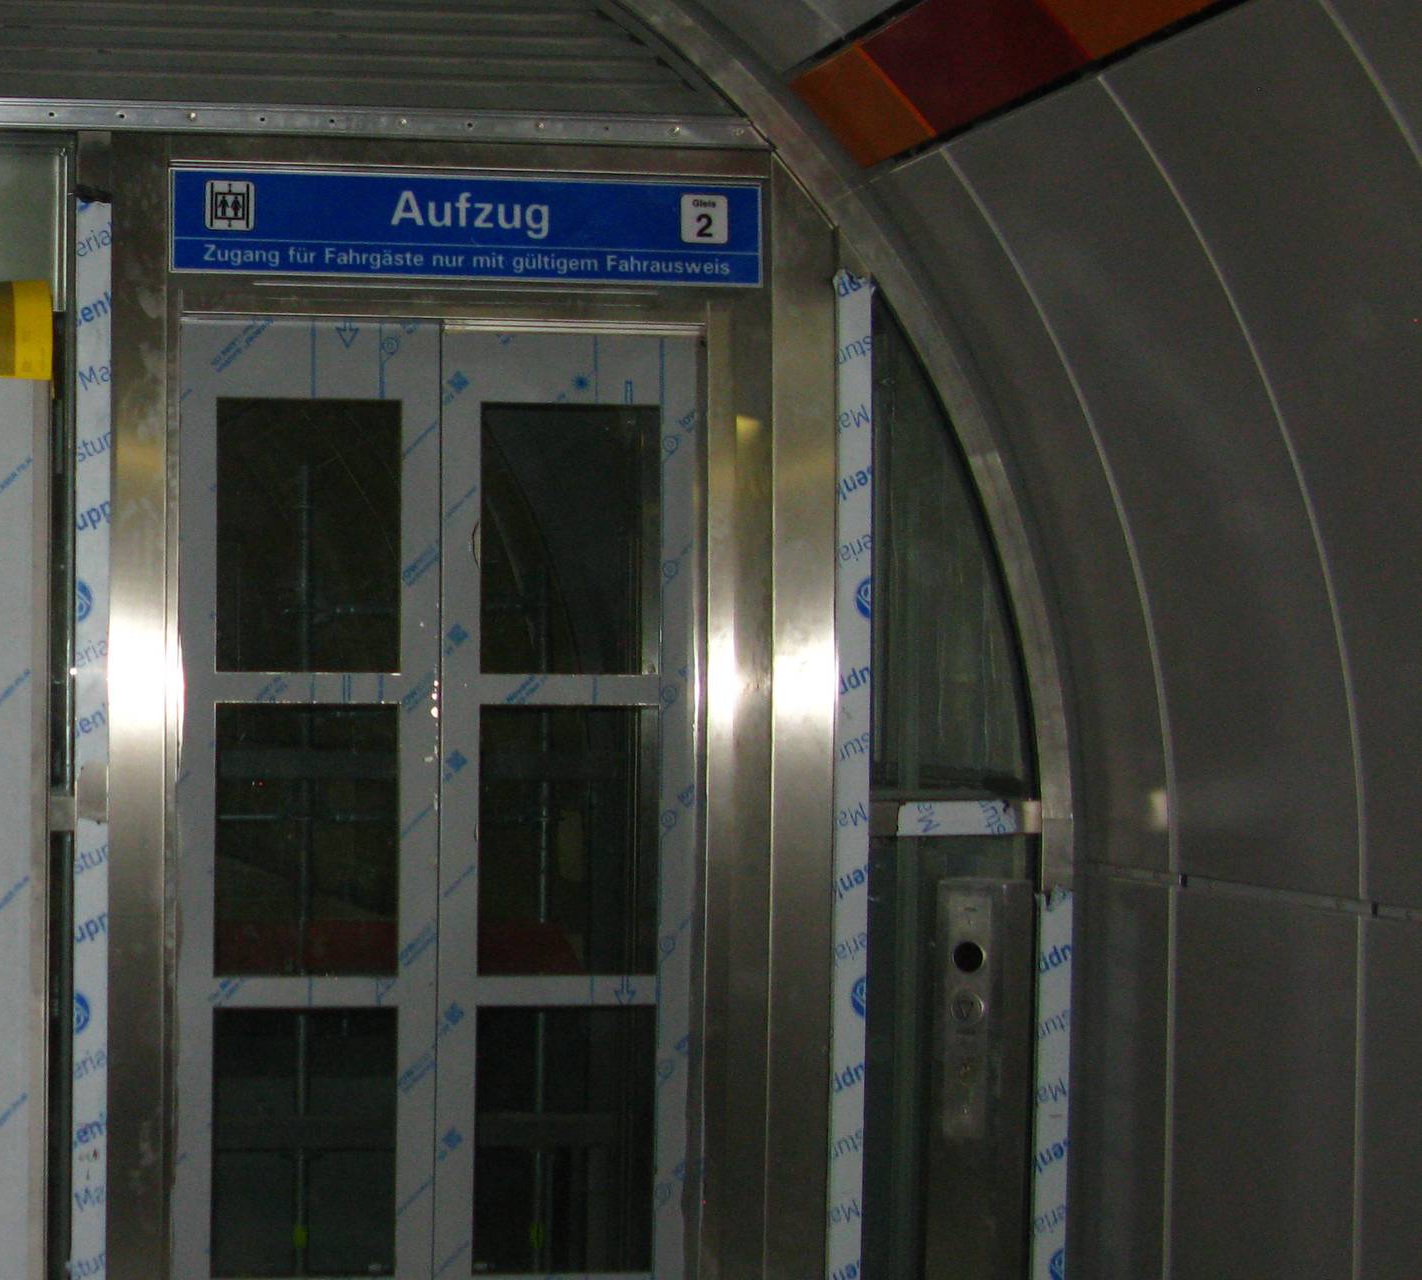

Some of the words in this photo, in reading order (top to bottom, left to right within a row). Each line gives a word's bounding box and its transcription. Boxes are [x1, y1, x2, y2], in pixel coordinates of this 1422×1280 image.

[390, 190, 550, 239] Aufzug
[692, 199, 716, 208] Gleis
[696, 213, 713, 237] 2
[203, 244, 280, 267] Zugang
[288, 247, 315, 264] für
[324, 248, 424, 268] Fahrgäste
[432, 256, 464, 268] nur
[472, 252, 504, 269] mit
[513, 253, 598, 274] gültigem
[606, 255, 731, 275] Fahrausweis
